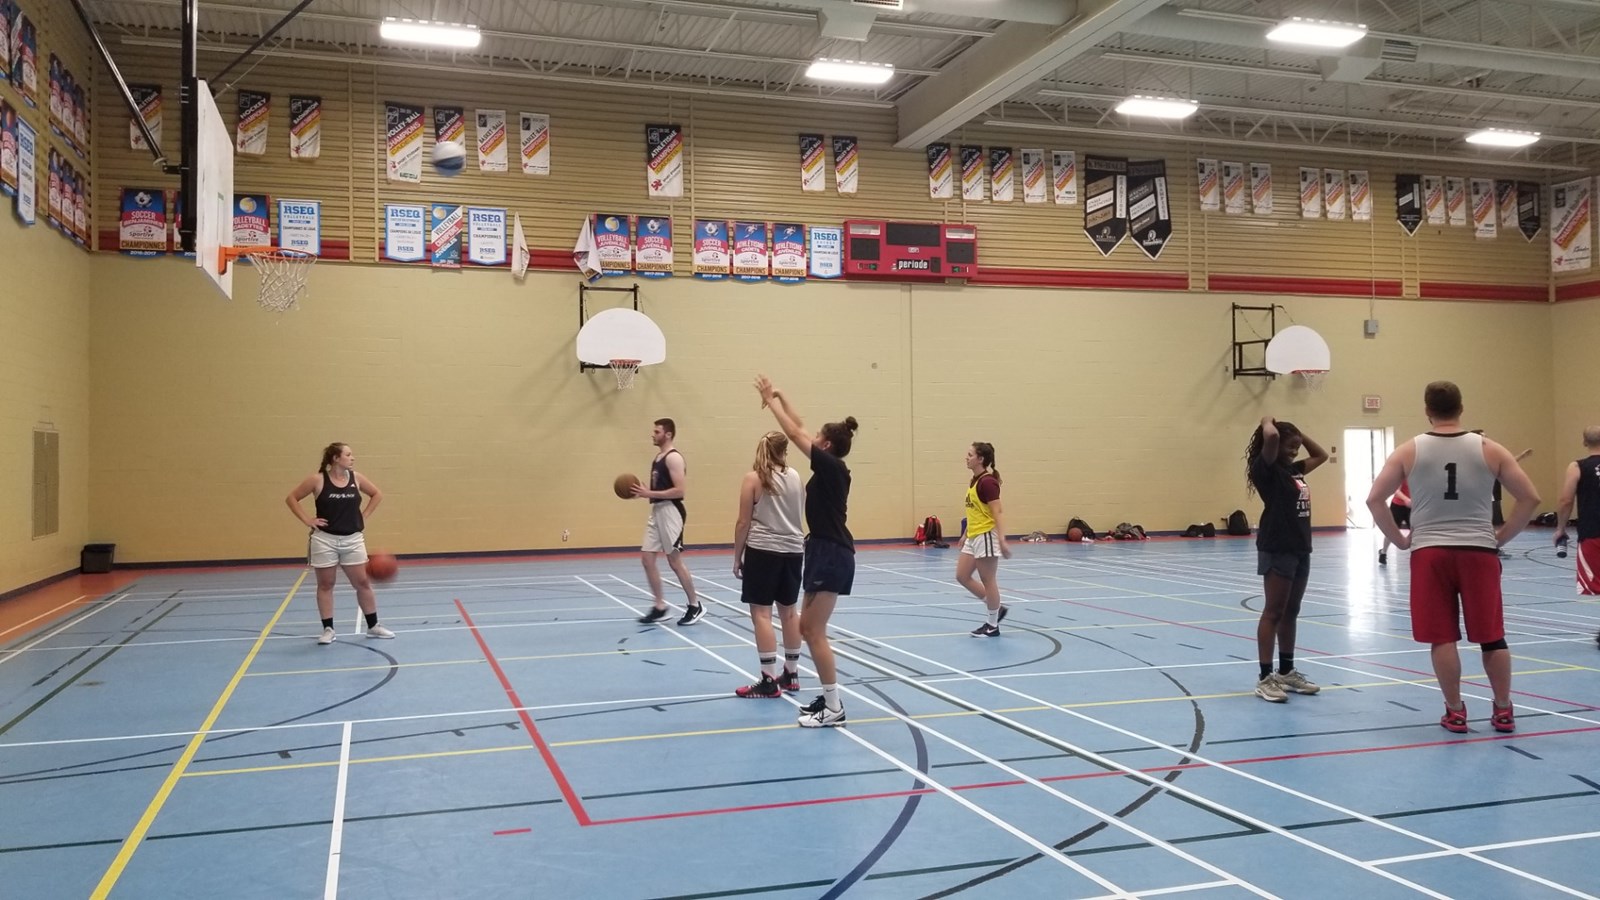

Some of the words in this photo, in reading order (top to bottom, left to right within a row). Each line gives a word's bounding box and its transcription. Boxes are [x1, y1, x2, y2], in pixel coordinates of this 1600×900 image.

[240, 98, 267, 119] HOCKEY
[388, 111, 420, 138] VOLLEY-BALL
[479, 120, 504, 144] BASKET-BALL
[131, 210, 156, 220] SOCCER
[283, 205, 315, 215] RSEQ
[390, 208, 421, 218] RSEQ
[472, 213, 502, 223] RSEQ
[434, 212, 461, 235] VOLLEYBALL
[597, 234, 628, 244] VOLLEYBALL
[644, 236, 664, 244] SOCCER
[813, 232, 839, 241] RSEQ
[121, 240, 166, 249] CHAMPIONNES
[702, 238, 722, 247] SOCCER
[637, 262, 672, 270] CHAMPIONNES
[696, 265, 727, 273] CHAMPIONS
[898, 259, 928, 270] periode
[736, 267, 766, 275] CHAMPIONS
[774, 268, 805, 276] CHAMPIONS
[1443, 462, 1459, 500] 1
